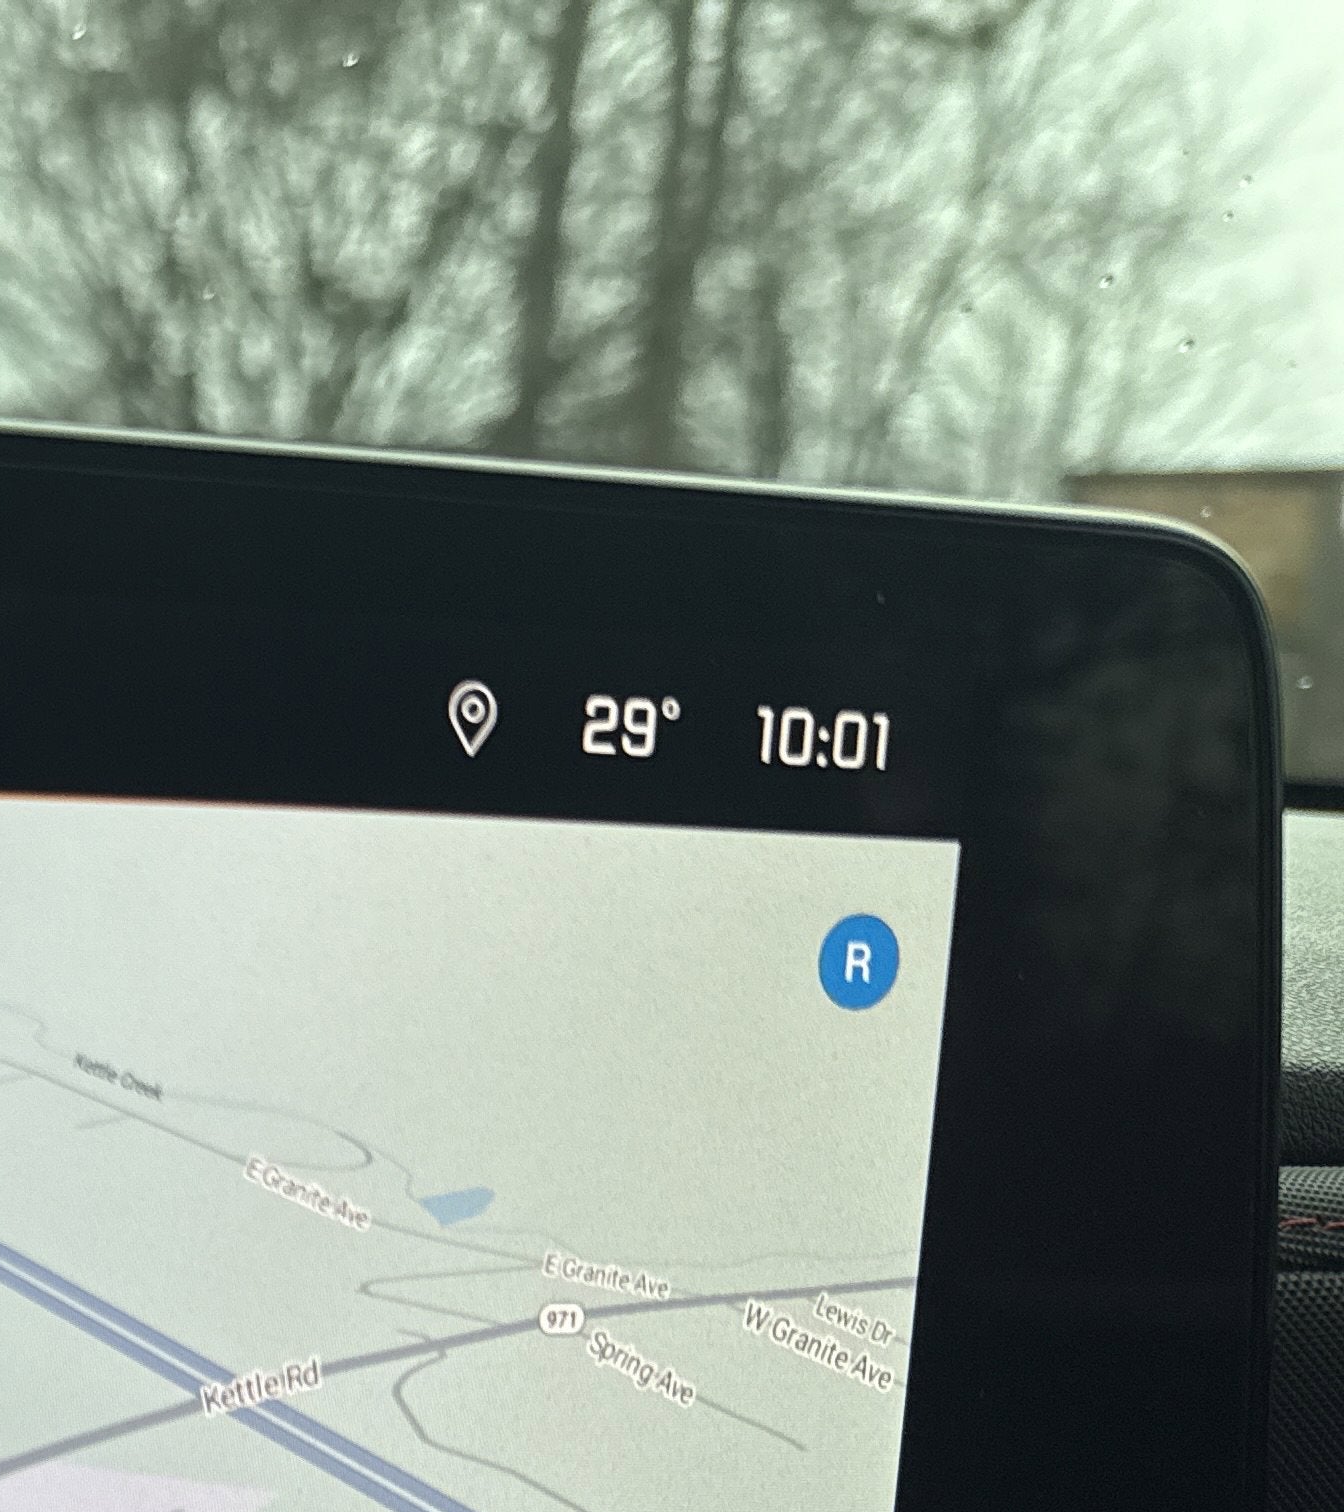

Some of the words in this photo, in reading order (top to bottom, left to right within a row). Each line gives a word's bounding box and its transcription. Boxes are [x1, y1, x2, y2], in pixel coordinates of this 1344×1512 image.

[582, 694, 681, 758] 29°
[757, 704, 890, 771] 10:01
[844, 940, 871, 983] R
[246, 1157, 261, 1180] E
[262, 1165, 333, 1214] Granite
[336, 1199, 369, 1230] Ave
[543, 1253, 559, 1276] E
[562, 1258, 631, 1290] Granite
[635, 1273, 669, 1299] Ave
[546, 1310, 578, 1329] 971
[744, 1302, 769, 1330] W
[771, 1318, 852, 1370] Granite
[852, 1357, 894, 1391] Ave
[814, 1293, 868, 1335] Lewis
[869, 1318, 895, 1346] Dr
[202, 1373, 282, 1414] Kettle
[285, 1360, 321, 1392] Rd
[589, 1331, 655, 1386] Spring
[656, 1371, 696, 1406] Ave
